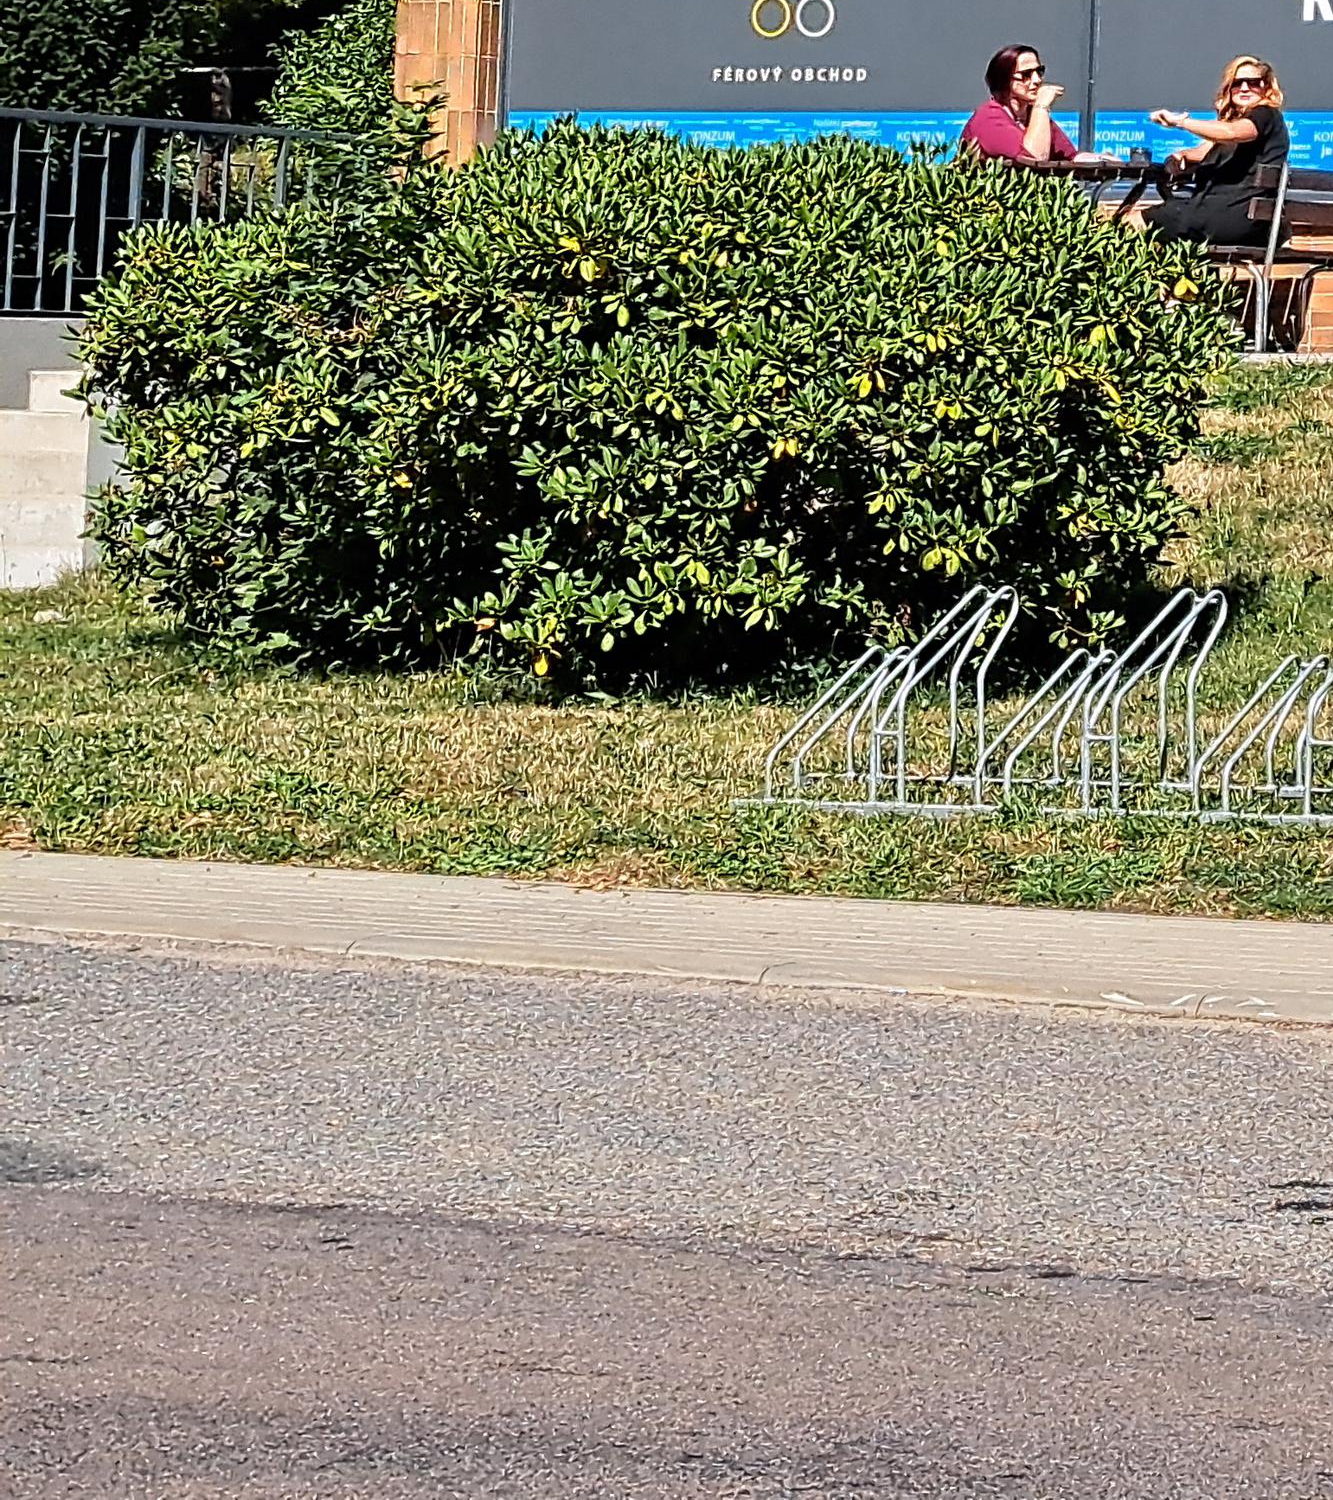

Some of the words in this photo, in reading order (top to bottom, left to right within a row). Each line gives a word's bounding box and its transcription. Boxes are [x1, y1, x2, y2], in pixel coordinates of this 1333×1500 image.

[711, 65, 784, 83] FÉROVÝ
[790, 66, 868, 82] OBCHOD
[1095, 131, 1145, 142] KONZUM
